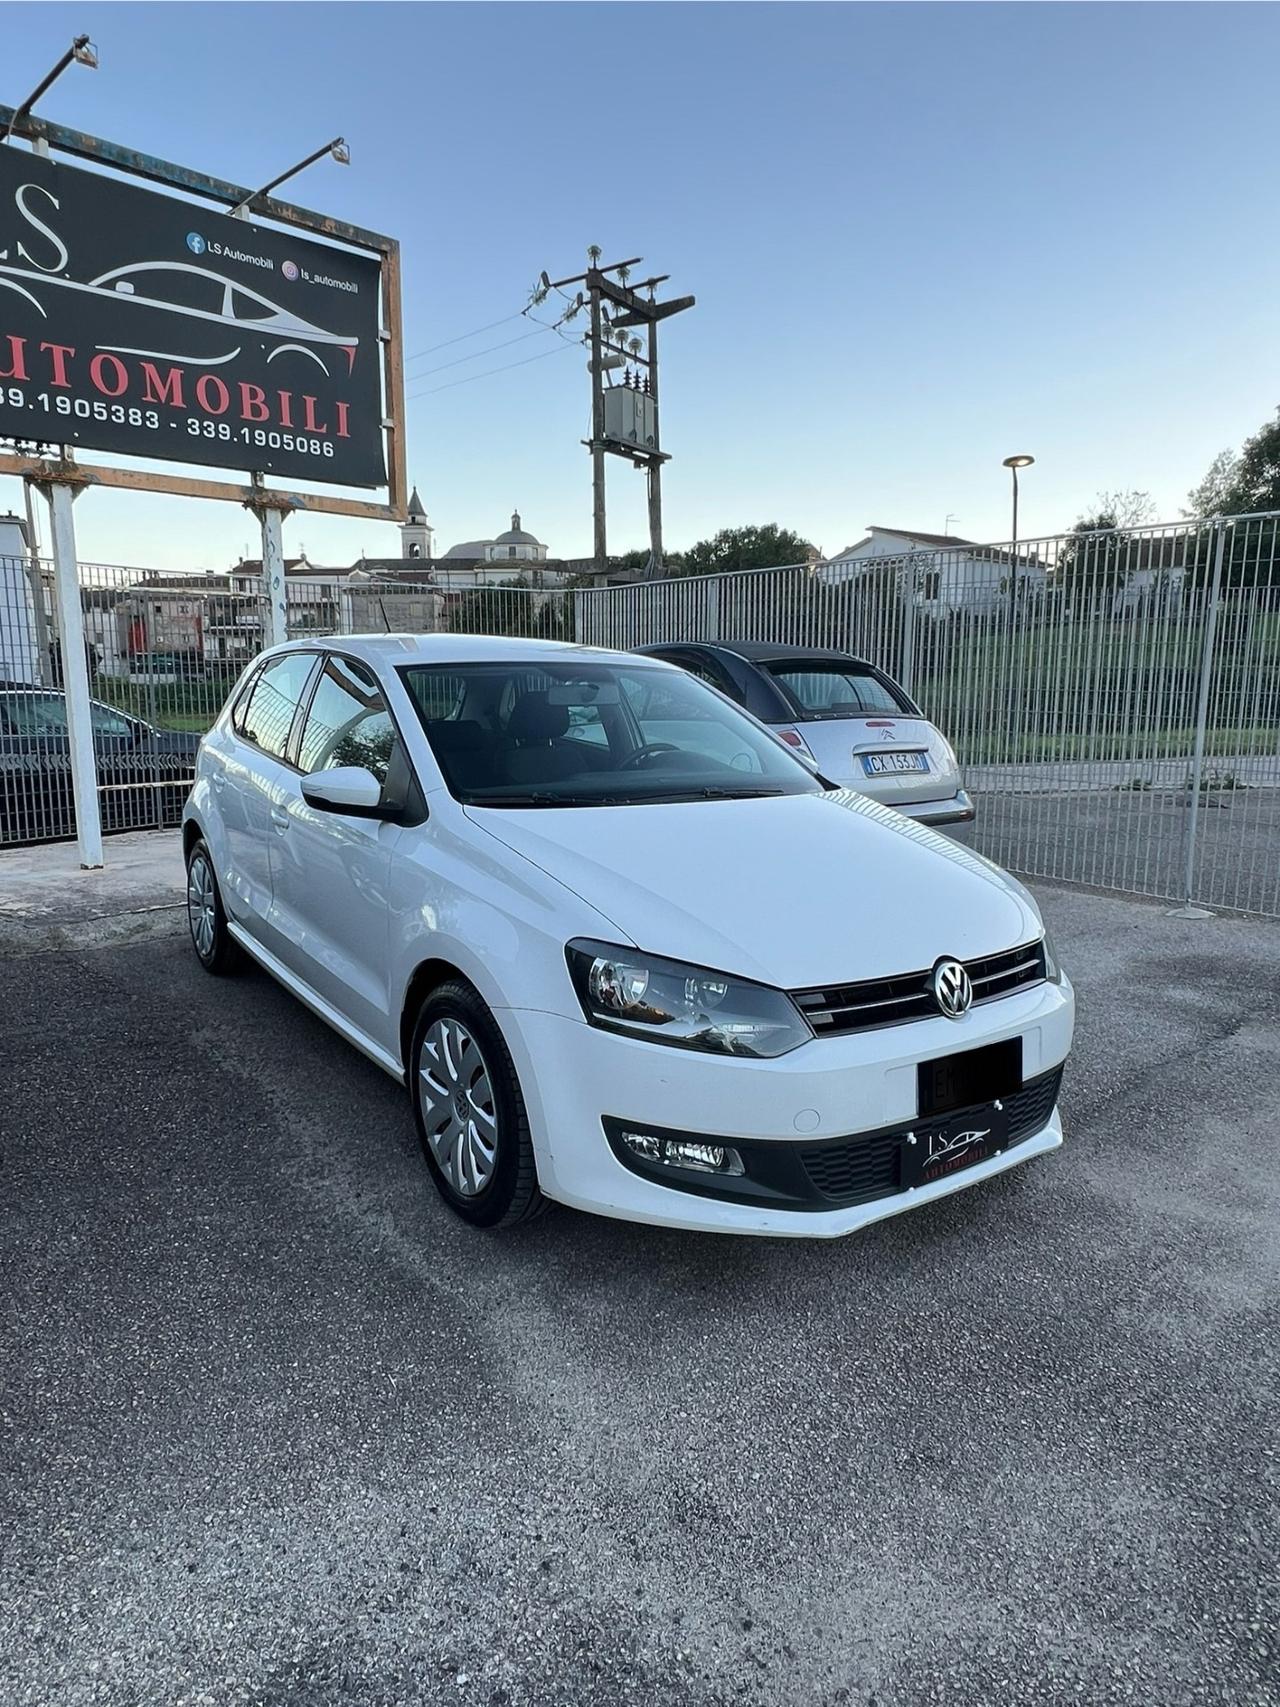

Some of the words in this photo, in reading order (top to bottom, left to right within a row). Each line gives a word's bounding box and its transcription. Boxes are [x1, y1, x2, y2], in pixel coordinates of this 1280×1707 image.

[207, 241, 221, 255] LS
[223, 246, 274, 270] Automobili
[187, 417, 335, 458] 339.1905086
[871, 756, 888, 771] CX
